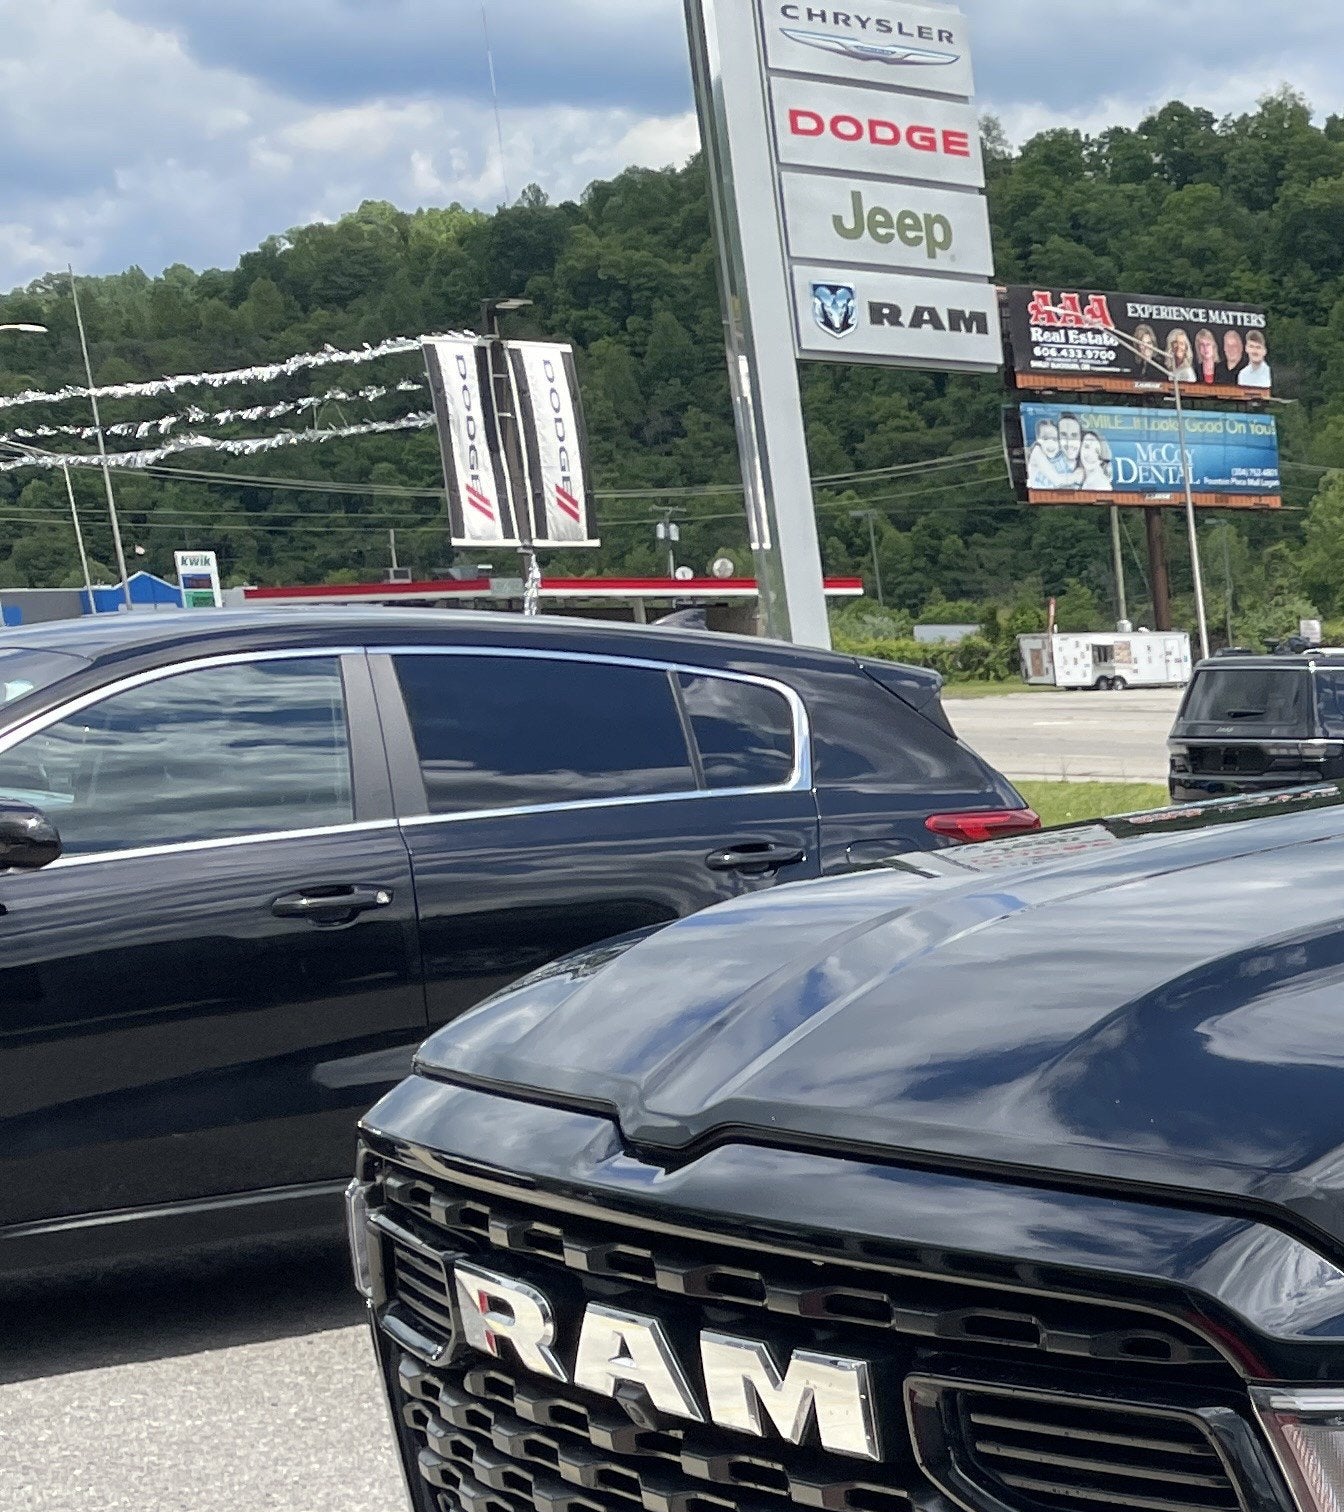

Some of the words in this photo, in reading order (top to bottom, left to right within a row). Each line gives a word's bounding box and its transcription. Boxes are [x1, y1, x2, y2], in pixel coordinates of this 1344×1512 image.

[780, 4, 954, 44] CHRYSLER
[789, 109, 970, 157] DODGE
[832, 190, 953, 258] Jeep
[868, 301, 988, 335] RAM
[1028, 290, 1115, 330] AAA
[1126, 302, 1207, 323] EXPERIENCE
[1208, 309, 1267, 329] MATTERS
[1030, 327, 1066, 343] Real
[1067, 329, 1119, 347] Estate
[456, 355, 483, 496] DODGE
[543, 359, 572, 496] DODGE
[1185, 418, 1224, 433] Good
[1225, 420, 1247, 435] On
[1114, 457, 1200, 485] DENTAL
[454, 1259, 882, 1463] RAM
